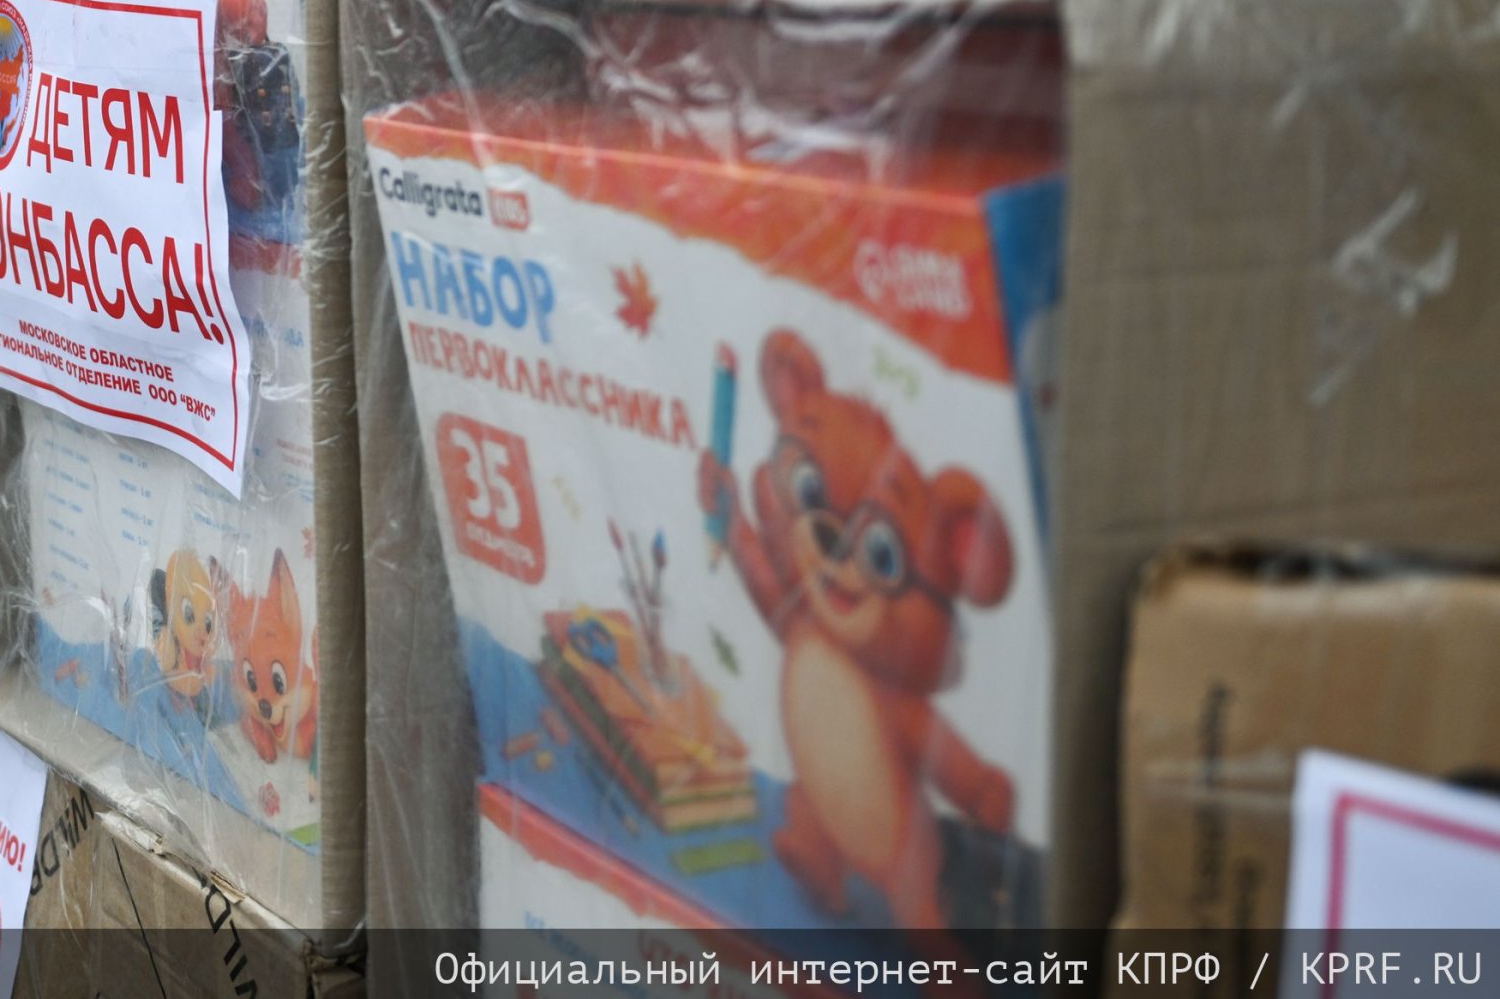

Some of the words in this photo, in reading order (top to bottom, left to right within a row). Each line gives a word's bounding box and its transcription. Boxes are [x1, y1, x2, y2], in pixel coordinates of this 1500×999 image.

[26, 72, 184, 184] ДЕТЯМ
[379, 166, 484, 218] Calligrata
[389, 230, 554, 345] НАБОР
[19, 319, 87, 361] МОСКОВСКОЕ
[90, 347, 174, 383] ОБЛАСТНОЕ
[66, 360, 142, 395] ОТДЕЛЕНИЕ
[148, 383, 177, 406] ООО
[408, 320, 697, 450] ПЕРВОКЛАССНИКА
[449, 427, 522, 530] 35
